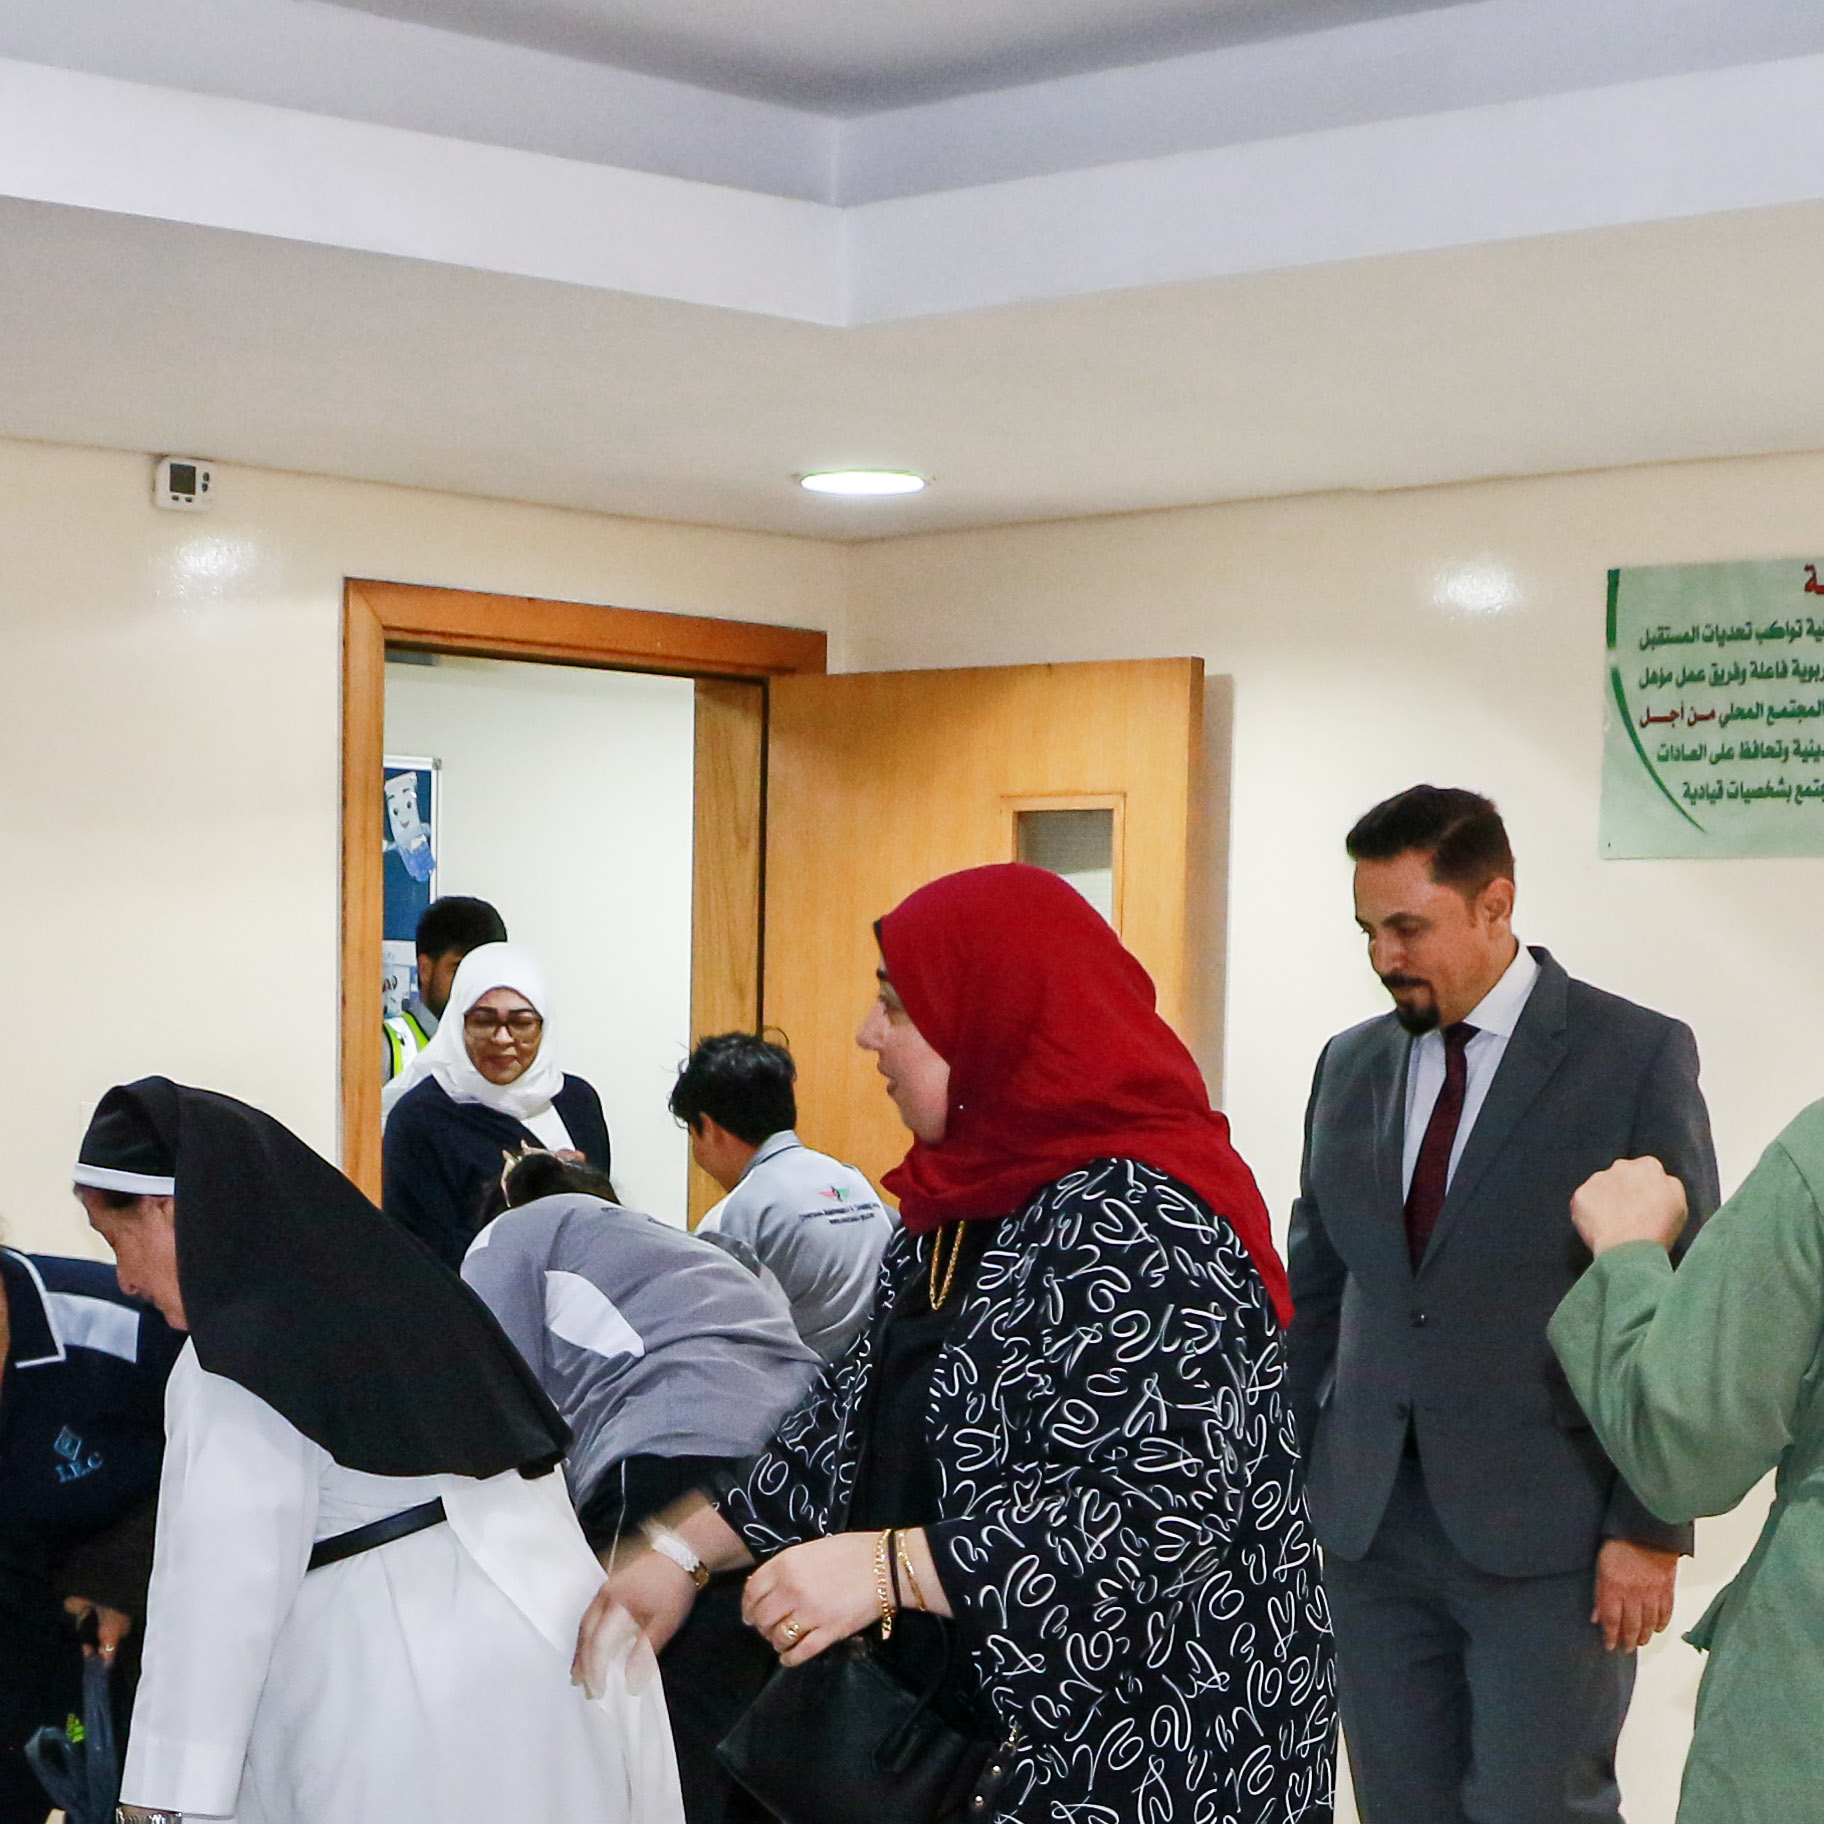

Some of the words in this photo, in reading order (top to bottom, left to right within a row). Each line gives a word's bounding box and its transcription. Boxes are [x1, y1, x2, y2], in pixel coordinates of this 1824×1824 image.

[1639, 625, 1699, 650] المستقبل
[1702, 621, 1752, 647] تحديات
[1756, 619, 1802, 645] تواكب
[1676, 665, 1705, 688] عمل
[1709, 662, 1747, 686] وفريق
[1750, 660, 1788, 679] فاعلة
[1688, 706, 1716, 727] من
[1656, 742, 1707, 762] العادات
[1710, 743, 1735, 765] على
[1739, 739, 1789, 763] وتحافظ
[1683, 779, 1723, 806] قيادية
[1727, 776, 1793, 804] بشخصيات
